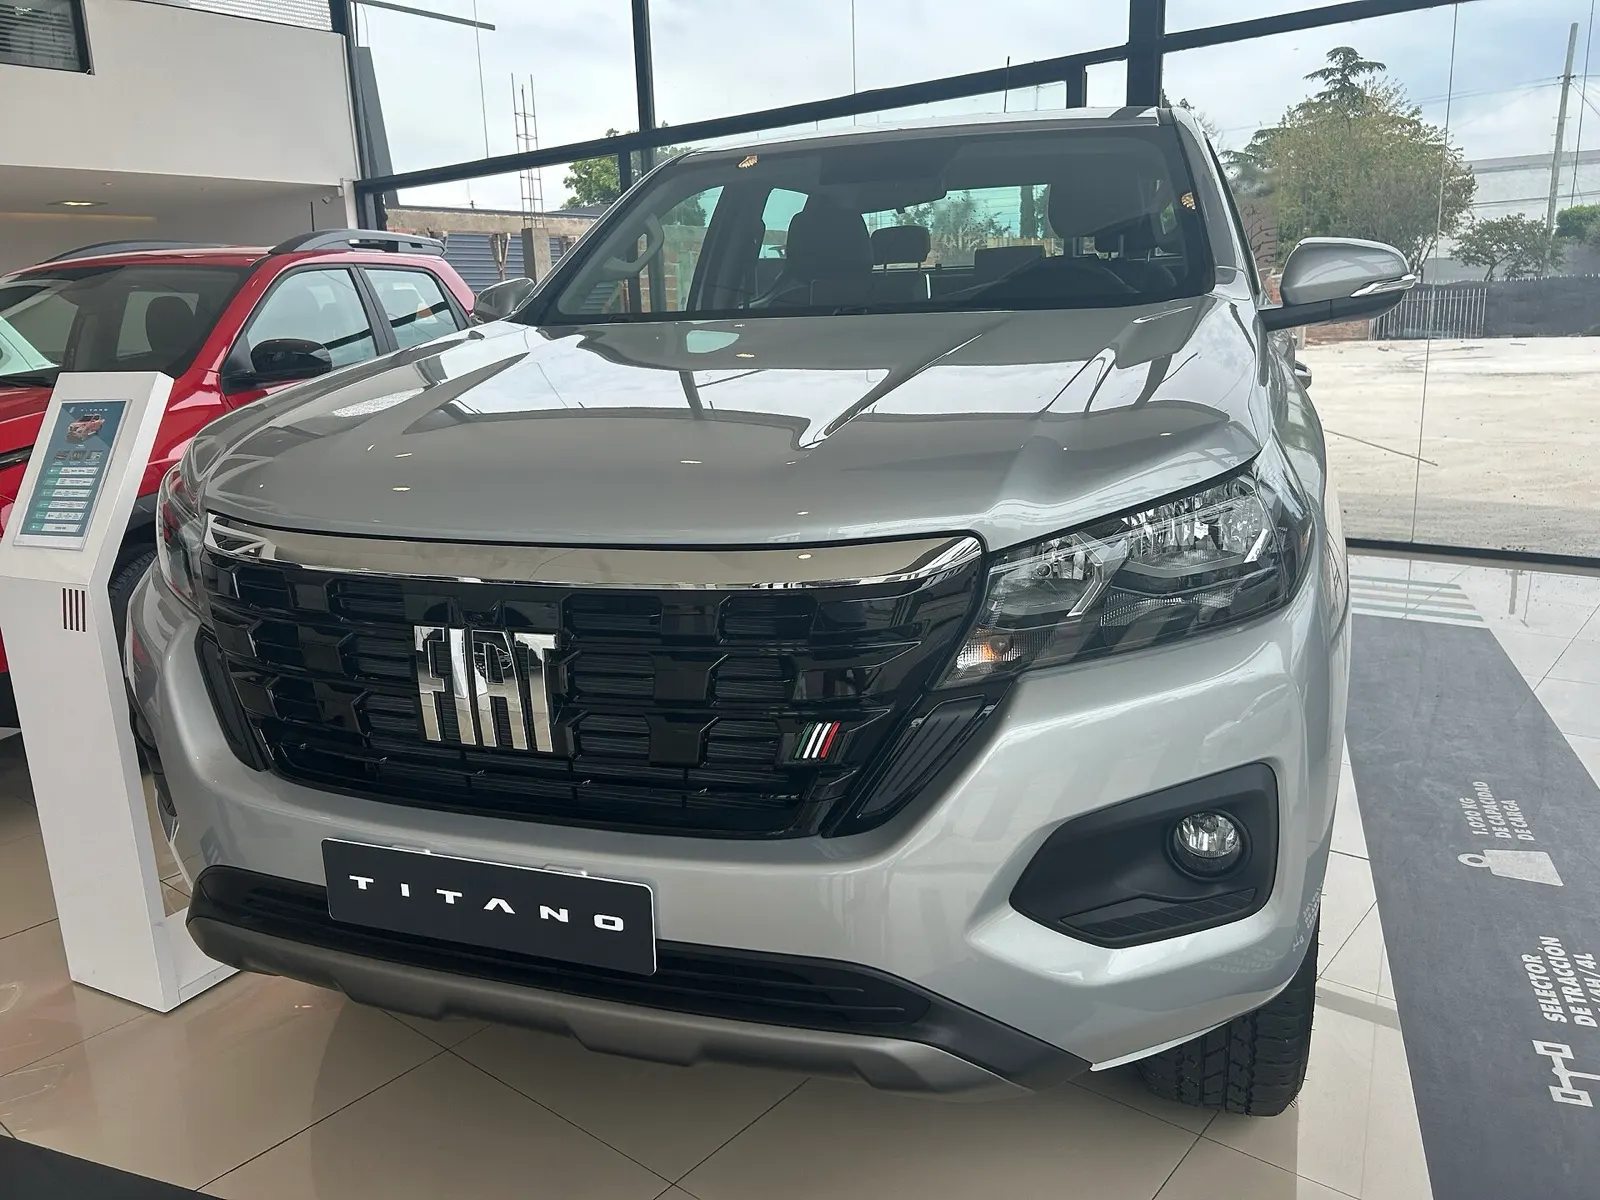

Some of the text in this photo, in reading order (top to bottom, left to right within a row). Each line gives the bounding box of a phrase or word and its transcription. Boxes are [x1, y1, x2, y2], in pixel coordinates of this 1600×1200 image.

[413, 625, 558, 752] FIAT
[1459, 797, 1489, 835] 1.020 KG
[1472, 781, 1512, 839] DE CAPACIDAD
[1500, 799, 1535, 841] DE CARGA
[349, 874, 624, 932] TITANO
[1521, 954, 1568, 1023] SELECTOR
[1537, 935, 1598, 1028] DE TRACCIÓN
